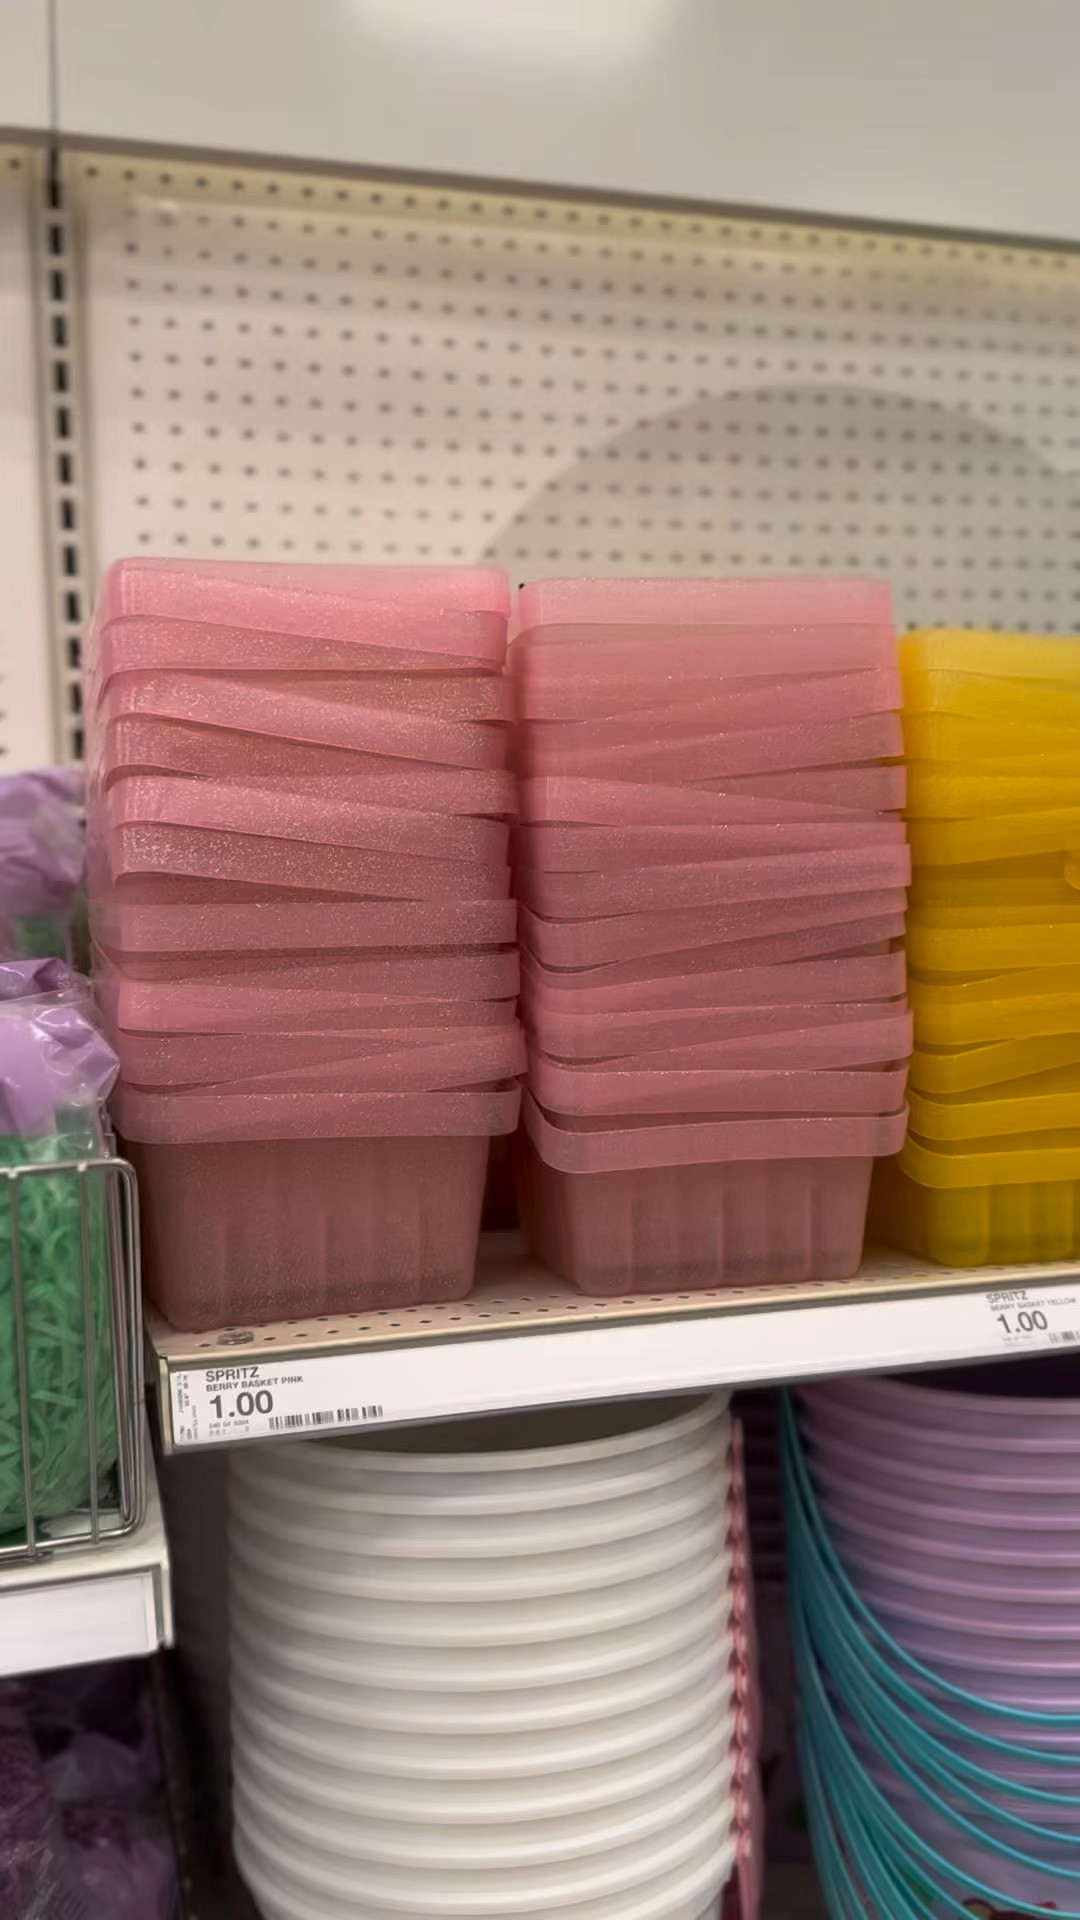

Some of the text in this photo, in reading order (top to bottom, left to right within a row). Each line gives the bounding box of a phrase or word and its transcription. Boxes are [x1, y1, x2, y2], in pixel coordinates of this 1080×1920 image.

[986, 1291, 1027, 1304] SPRITZ
[997, 1310, 1048, 1334] 1.00
[205, 1367, 259, 1382] SPRITZ
[206, 1376, 304, 1392] BERRY BASKET PINK
[209, 1390, 273, 1418] 1.00
